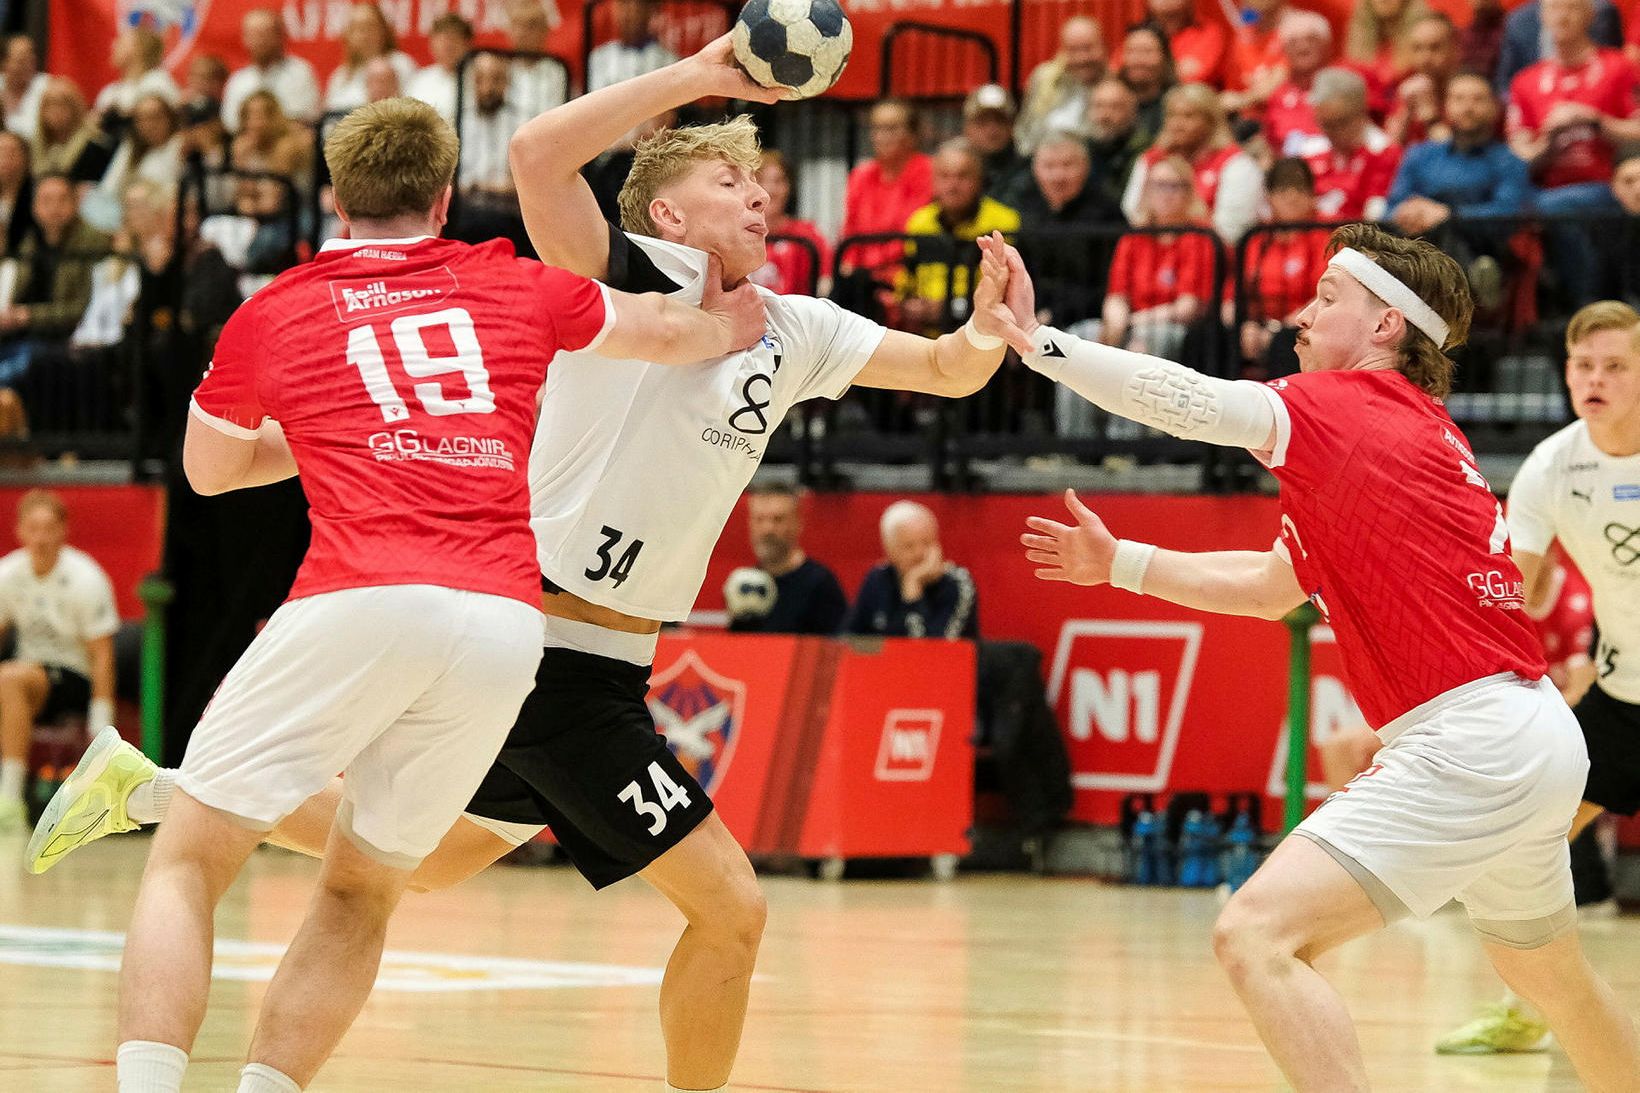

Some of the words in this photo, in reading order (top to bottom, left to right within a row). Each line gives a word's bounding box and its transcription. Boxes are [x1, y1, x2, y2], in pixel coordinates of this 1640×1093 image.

[345, 307, 497, 423] 19
[584, 525, 644, 589] 34
[1069, 667, 1160, 743] N1
[892, 728, 927, 760] N1
[616, 760, 692, 837] 34
